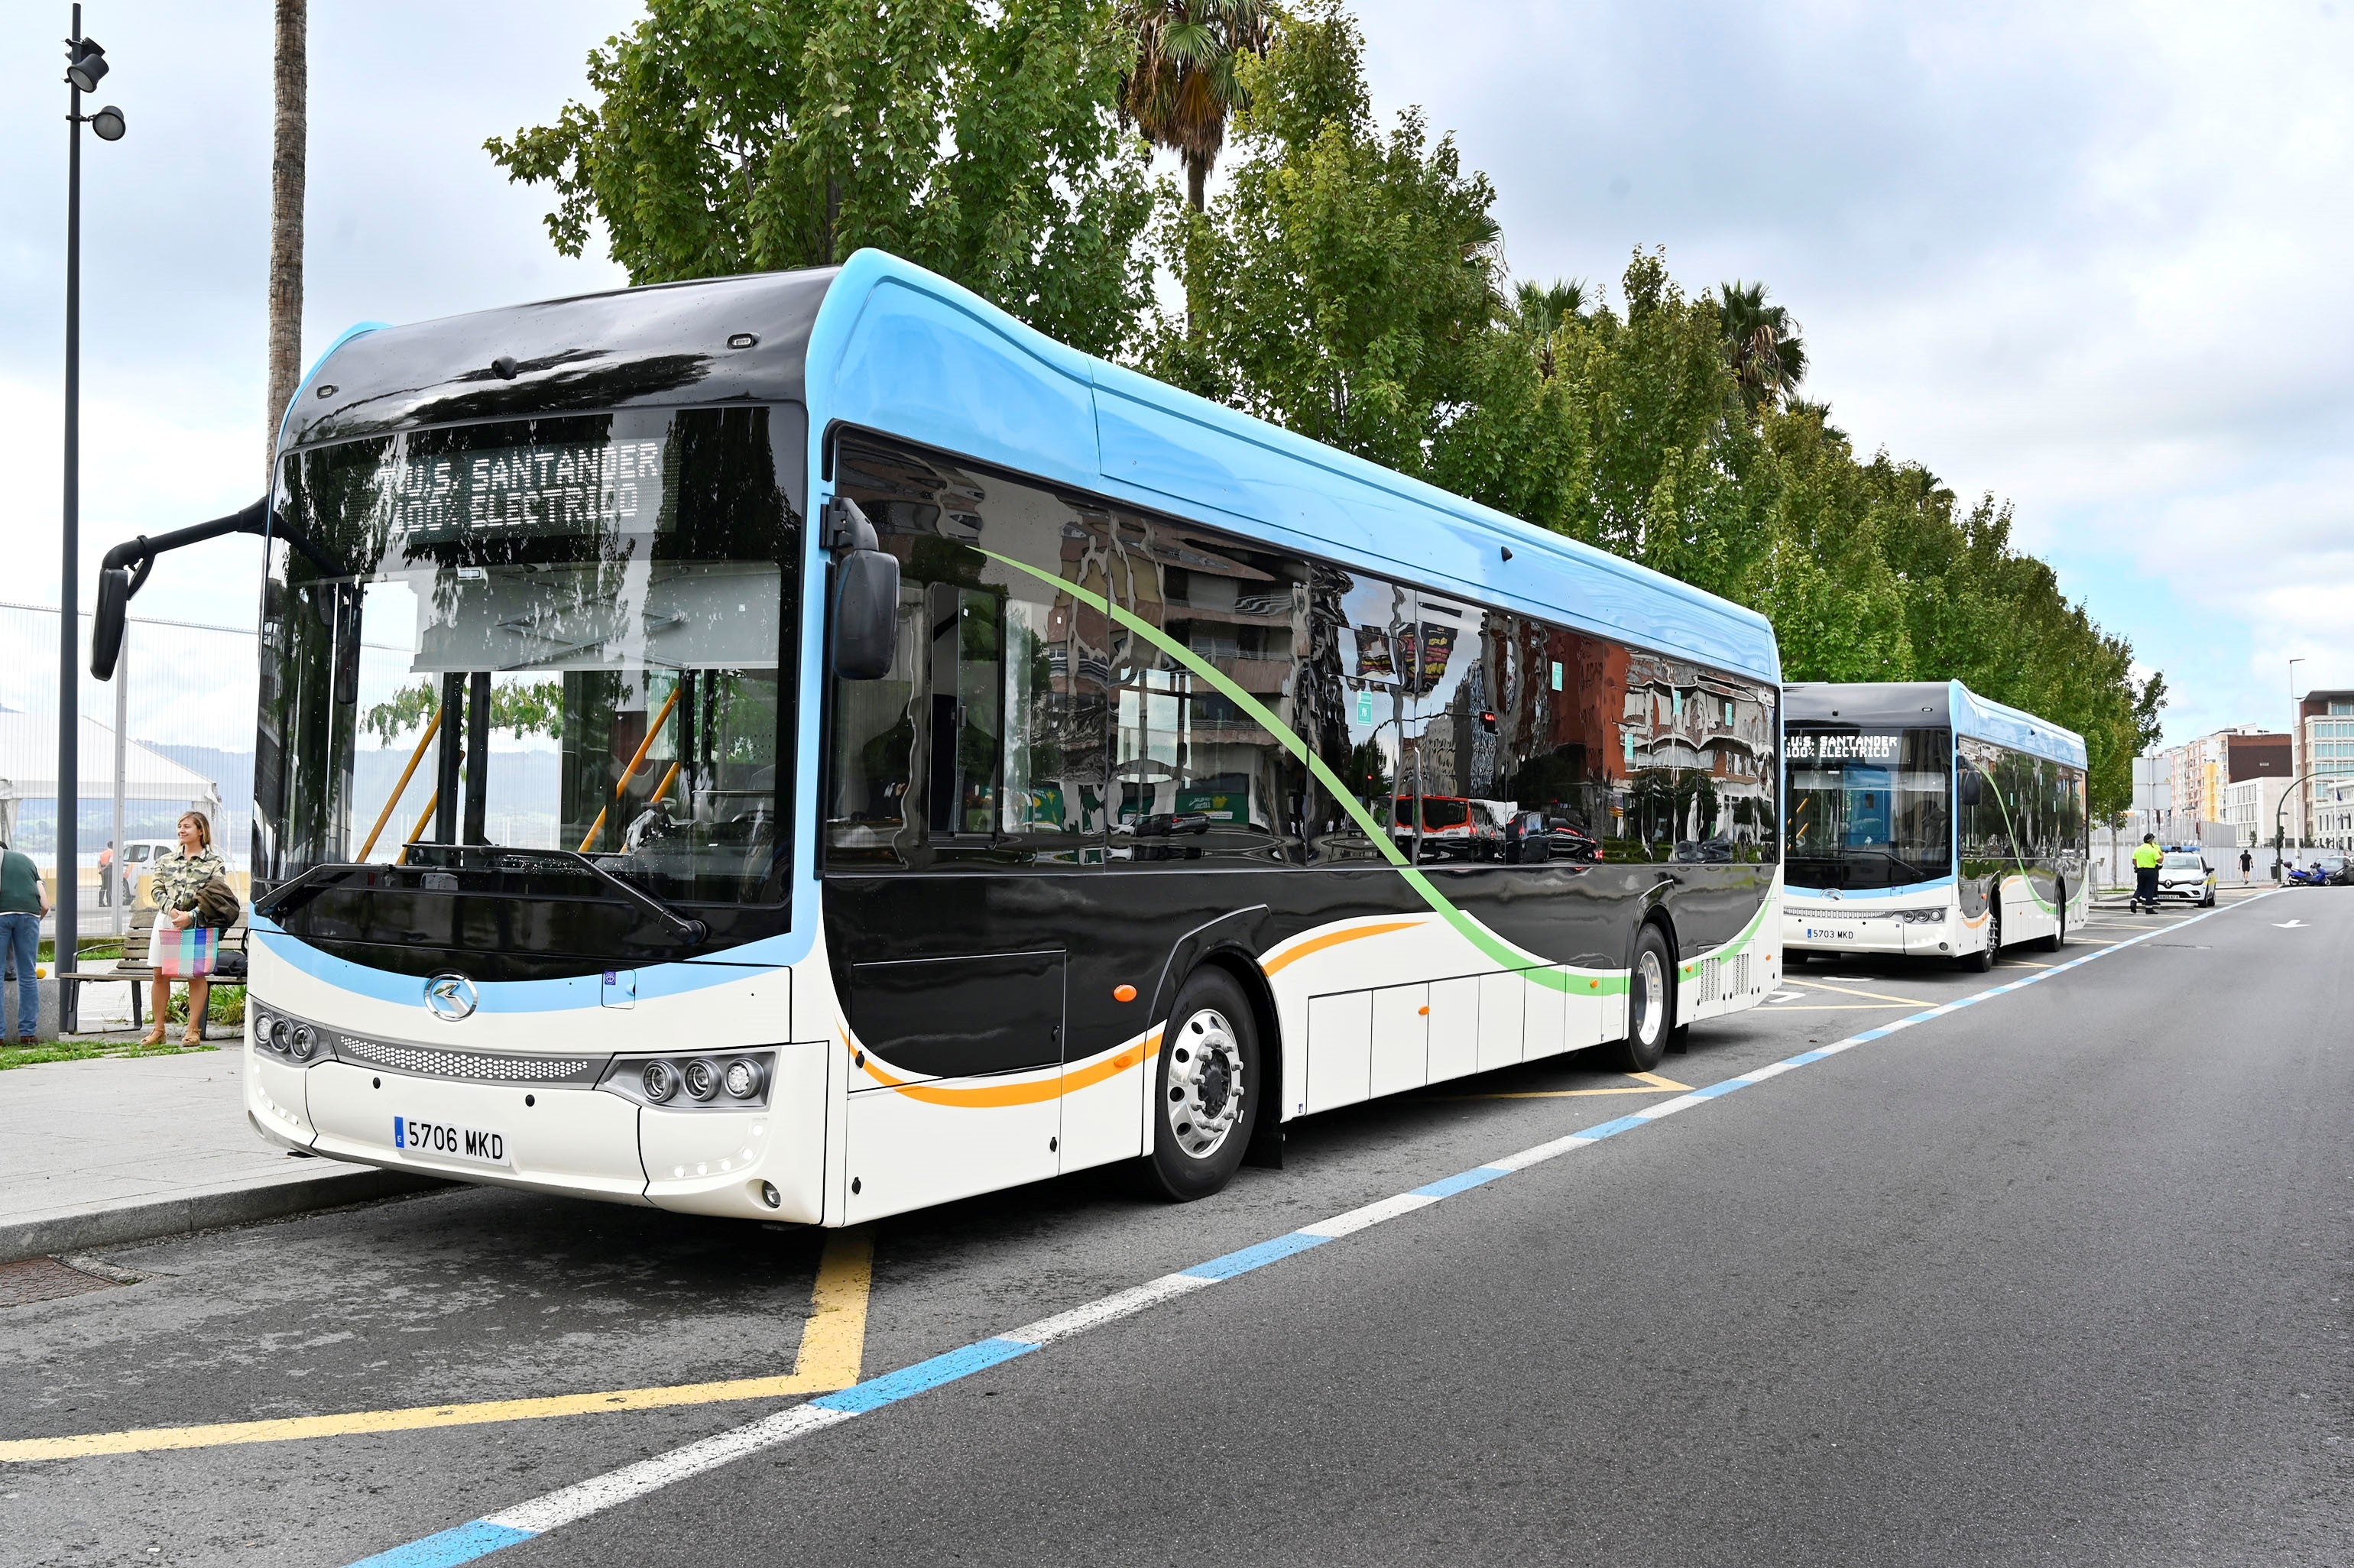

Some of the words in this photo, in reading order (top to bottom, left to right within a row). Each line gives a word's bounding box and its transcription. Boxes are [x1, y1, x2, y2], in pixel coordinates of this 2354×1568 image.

[472, 442, 658, 492] SANTANDER
[395, 497, 459, 533] 100%
[471, 482, 638, 528] ELECTRICO
[1785, 736, 1814, 747] .U.S.
[1819, 735, 1898, 747] SANTANDER
[1786, 747, 1814, 758] 100%
[1819, 747, 1890, 758] ELECTRICO
[1813, 929, 1834, 938] 5703
[1837, 931, 1853, 939] MKD
[397, 1135, 402, 1143] E
[409, 1122, 457, 1152] 5706
[465, 1129, 503, 1160] MKD
